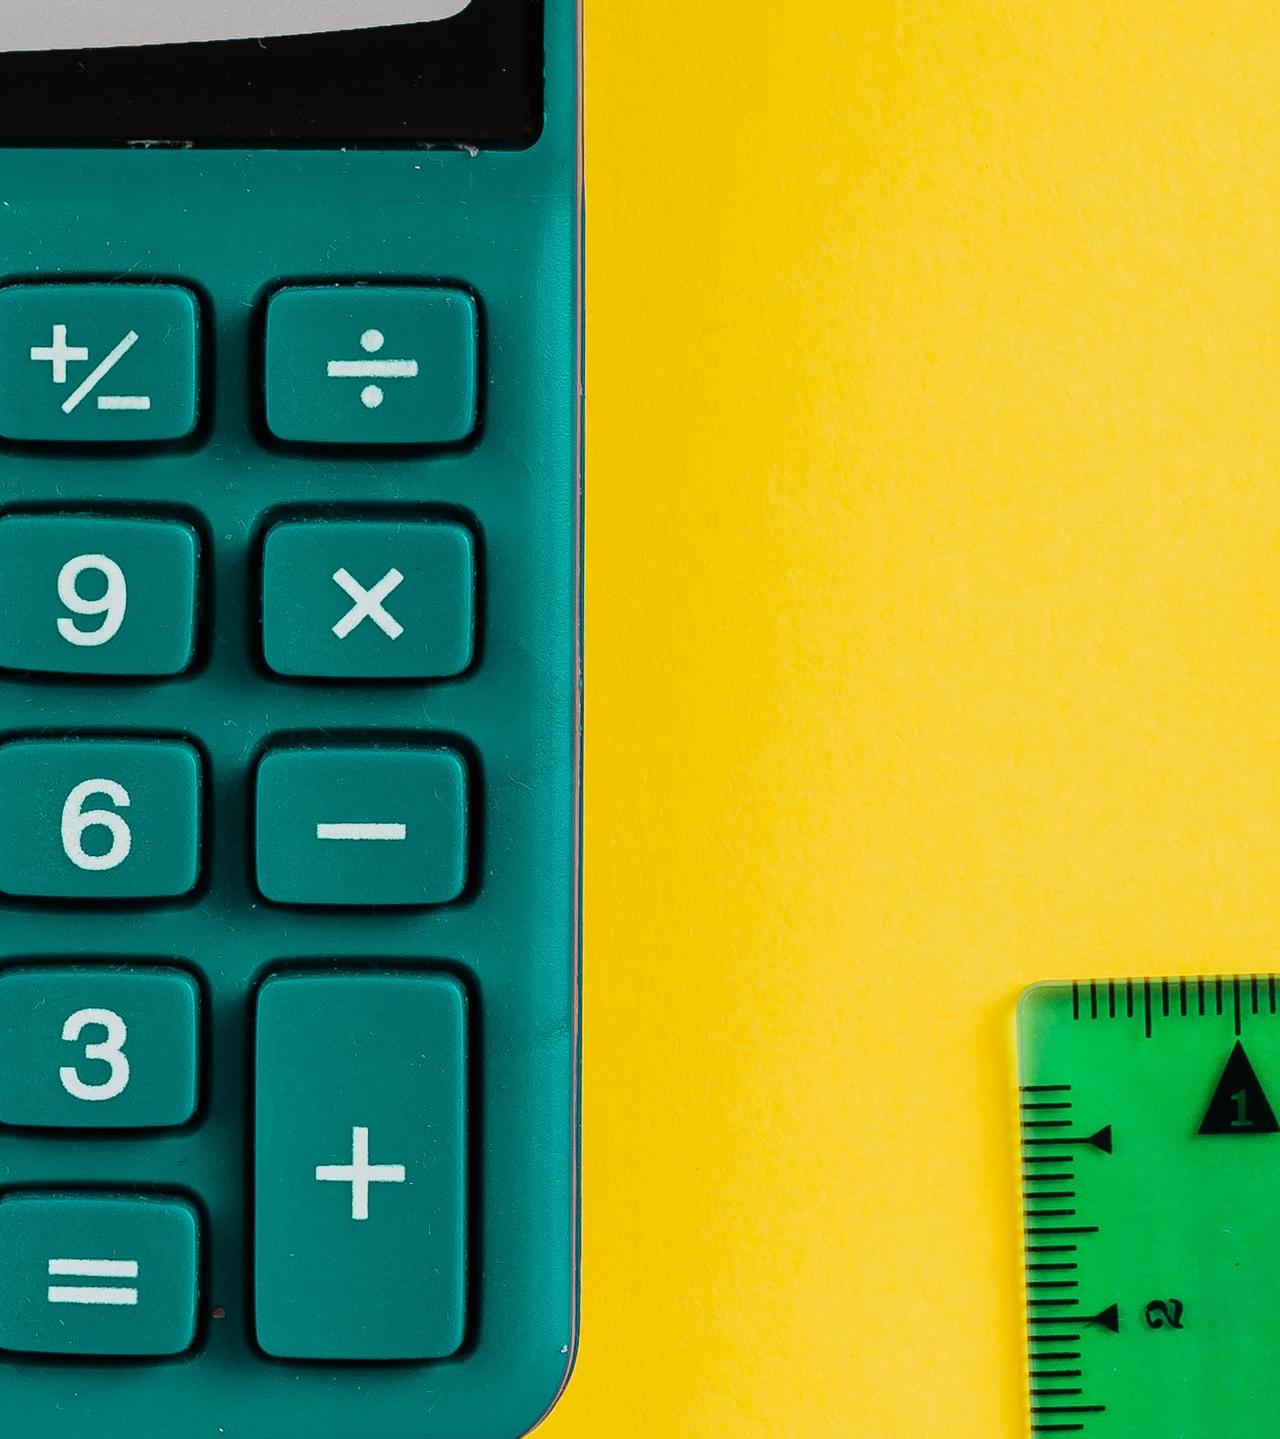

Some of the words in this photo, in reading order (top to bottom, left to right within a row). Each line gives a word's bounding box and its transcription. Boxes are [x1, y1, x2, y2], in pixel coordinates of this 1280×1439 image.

[56, 553, 128, 647] 9
[59, 777, 133, 872] 6
[58, 1007, 131, 1102] 3
[1229, 1087, 1255, 1128] 1
[1143, 1297, 1185, 1331] 2
